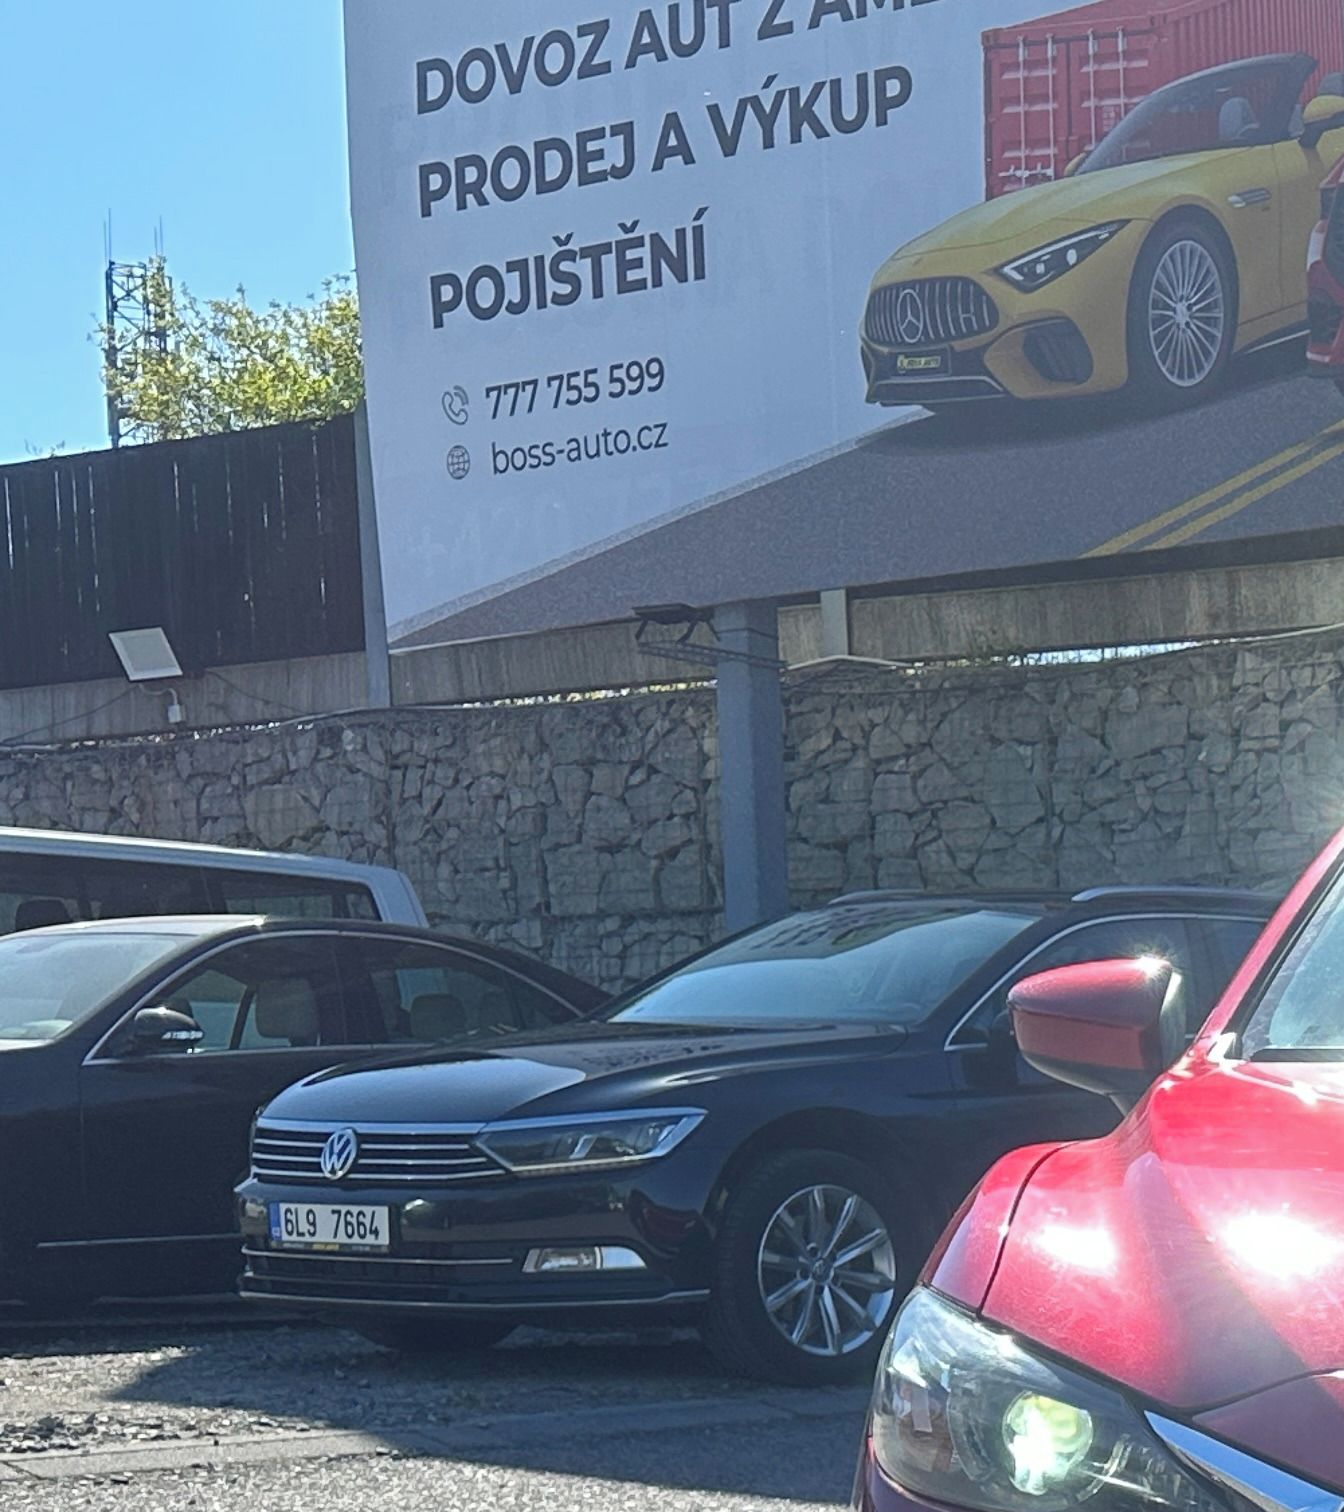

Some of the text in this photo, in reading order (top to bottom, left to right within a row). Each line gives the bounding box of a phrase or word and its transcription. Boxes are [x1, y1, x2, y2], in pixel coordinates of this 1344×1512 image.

[415, 18, 612, 115] DOVOZ
[624, 0, 741, 70] AUT
[757, 0, 795, 41] Z
[418, 65, 913, 218] PRODEJ A VÝKUP
[430, 206, 710, 329] POJIŠTĚNÍ
[485, 357, 665, 420] 777 755 599
[492, 421, 669, 475] boss-auto.cz
[284, 1207, 380, 1240] 6L9 7664
